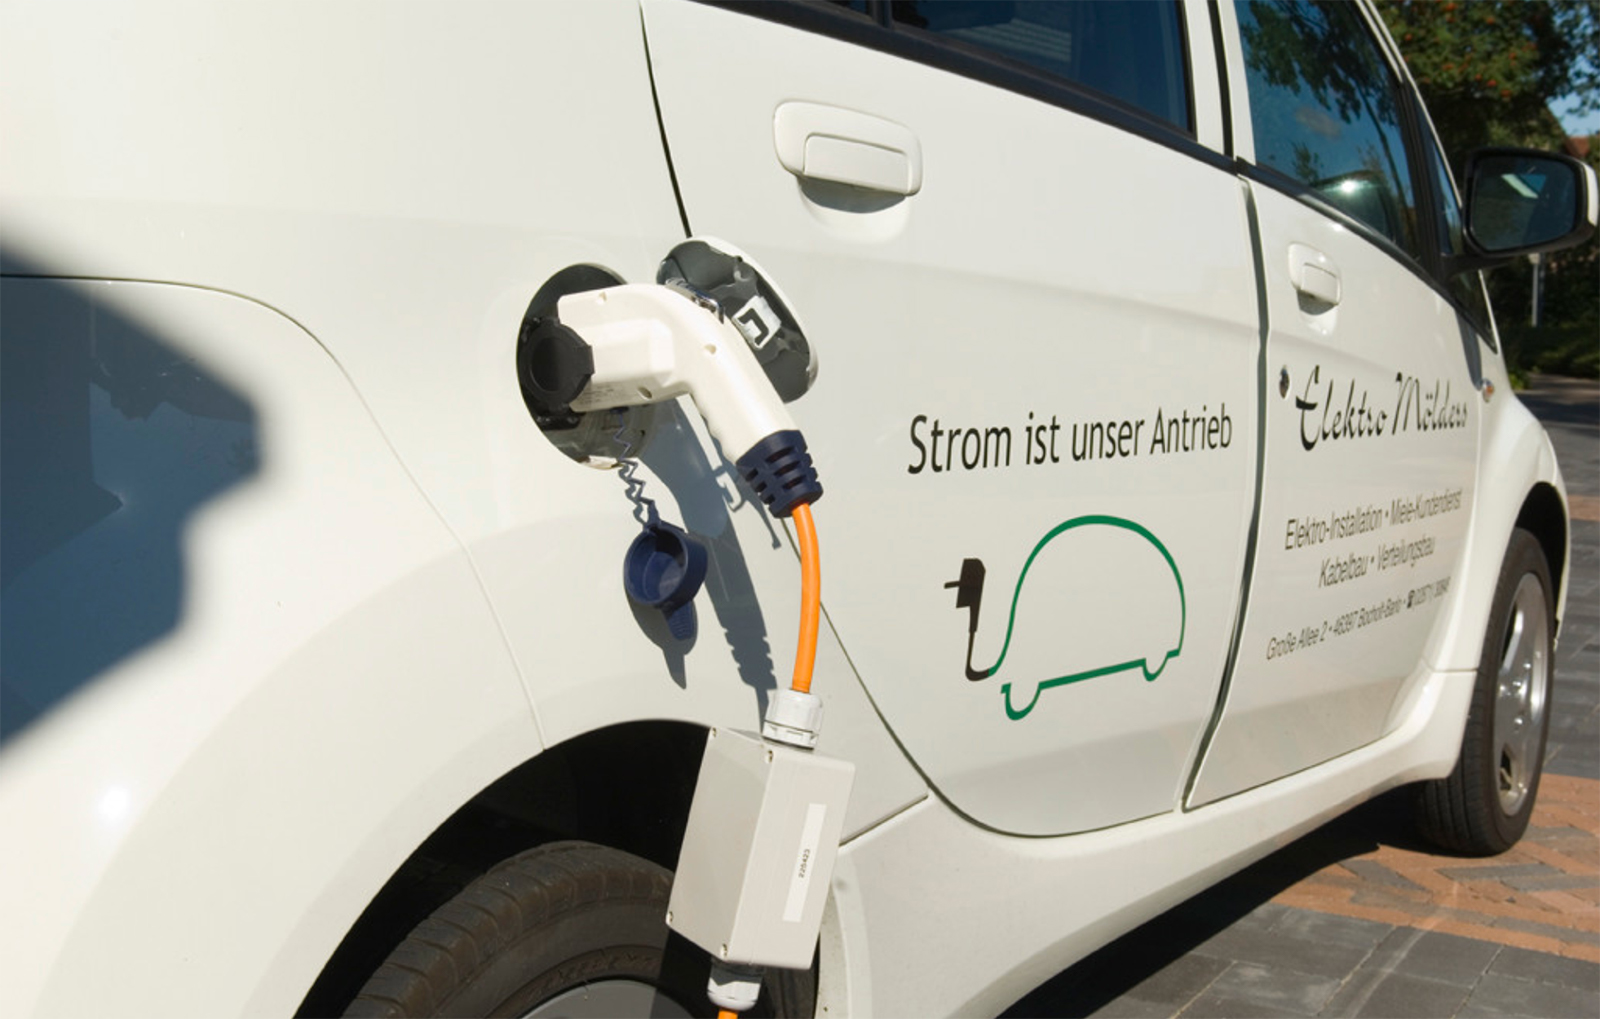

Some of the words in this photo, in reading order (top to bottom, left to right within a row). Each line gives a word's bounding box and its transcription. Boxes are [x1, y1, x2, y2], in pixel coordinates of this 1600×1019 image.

[1295, 364, 1387, 451] Elektro
[1391, 371, 1467, 436] Mölders
[907, 413, 1012, 475] Strom
[1025, 411, 1060, 466] ist
[1071, 418, 1145, 462] unser
[1149, 402, 1232, 455] Antrieb
[1284, 505, 1383, 551] Elektro-Installation
[1318, 552, 1369, 589] Kabelbau
[1377, 534, 1436, 570] Verteilungsbau
[1265, 632, 1297, 661] Große
[1297, 625, 1320, 651] Allee
[1319, 620, 1328, 643] 2
